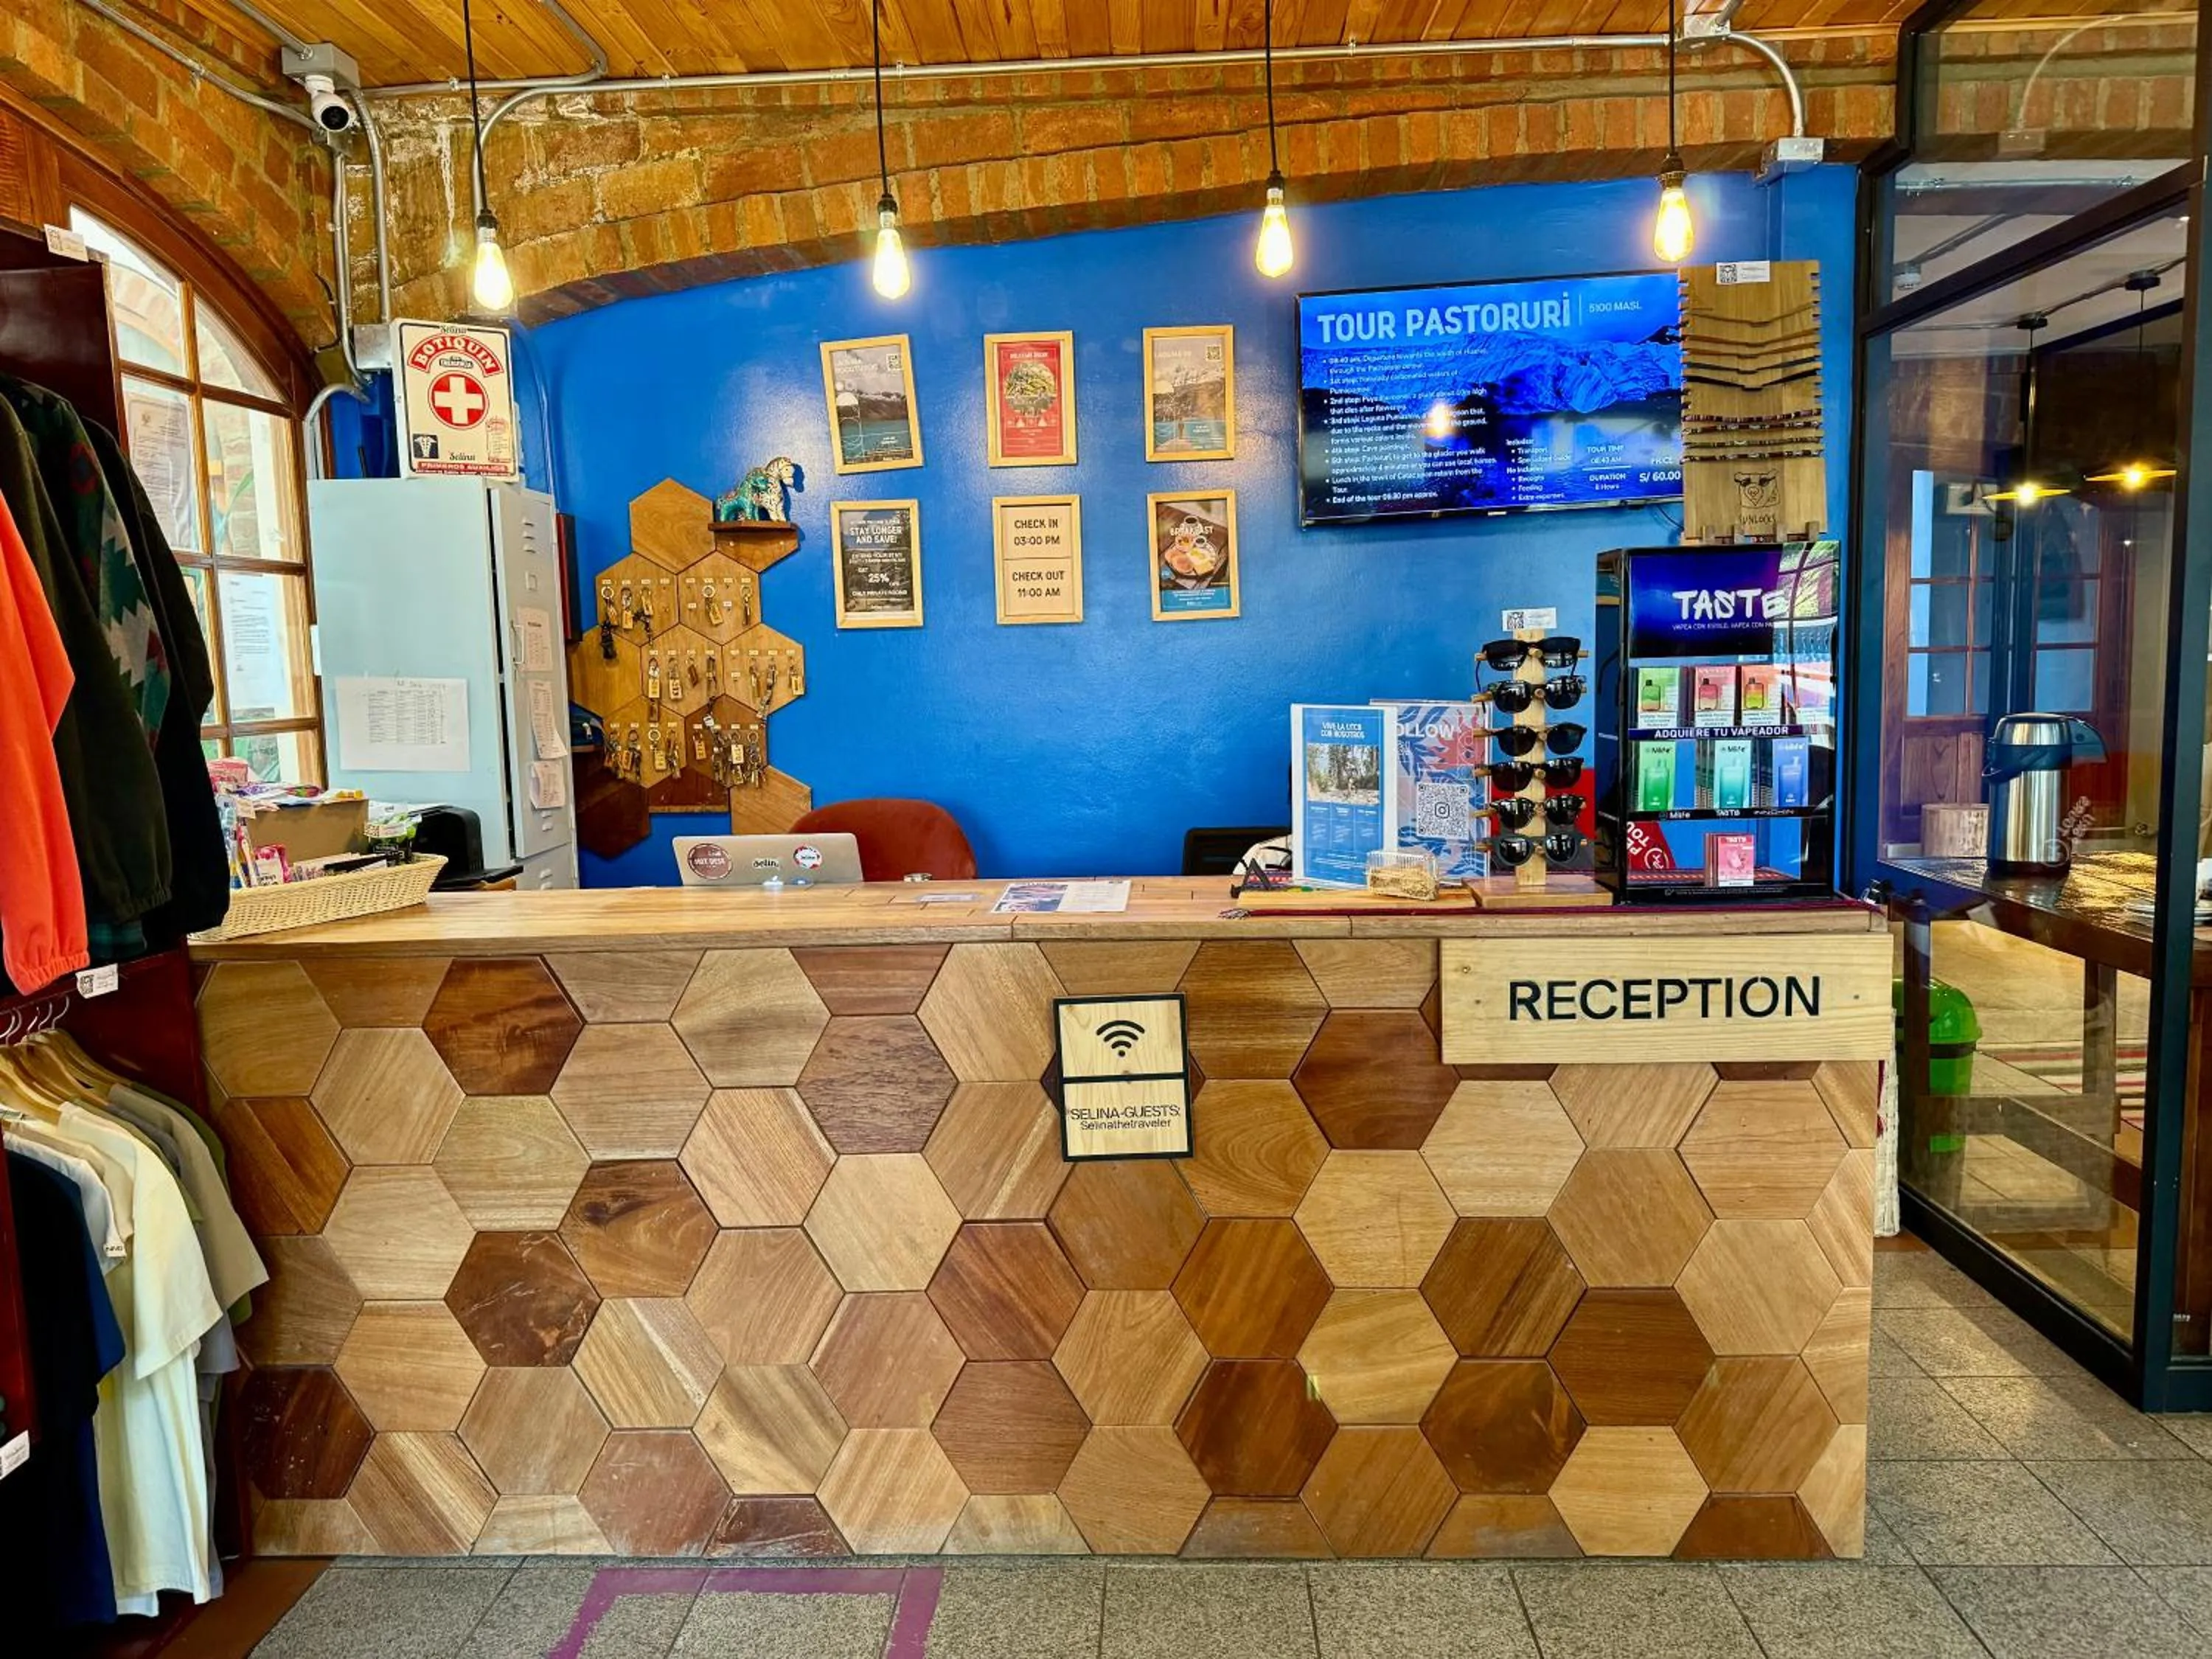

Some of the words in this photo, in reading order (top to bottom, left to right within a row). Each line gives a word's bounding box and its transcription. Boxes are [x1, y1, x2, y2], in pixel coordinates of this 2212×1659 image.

[1317, 313, 1396, 344] TOUR
[414, 335, 498, 374] BOTIQUIN
[1589, 473, 1627, 481] DURATION
[1652, 470, 1682, 481] 60.00
[1332, 495, 1346, 504] End
[1346, 495, 1354, 503] of
[1354, 494, 1366, 502] the
[1014, 518, 1046, 529] CHECK
[1048, 518, 1059, 529] IN
[849, 526, 869, 536] STAY
[871, 526, 903, 535] LONGER
[856, 535, 873, 544] AND
[1014, 536, 1043, 546] 03:00
[1045, 536, 1060, 545] PM
[868, 572, 890, 583] 25%
[1012, 571, 1043, 581] CHECK
[1046, 570, 1065, 580] OUT
[1045, 587, 1061, 597] AM
[1672, 588, 1791, 620] TASTE
[1396, 723, 1455, 740] OLLOW
[1655, 727, 1710, 738] ADQUIERE
[1714, 727, 1728, 737] TU
[1731, 726, 1790, 737] VAPEADOR
[1509, 975, 1821, 1021] RECEPTION
